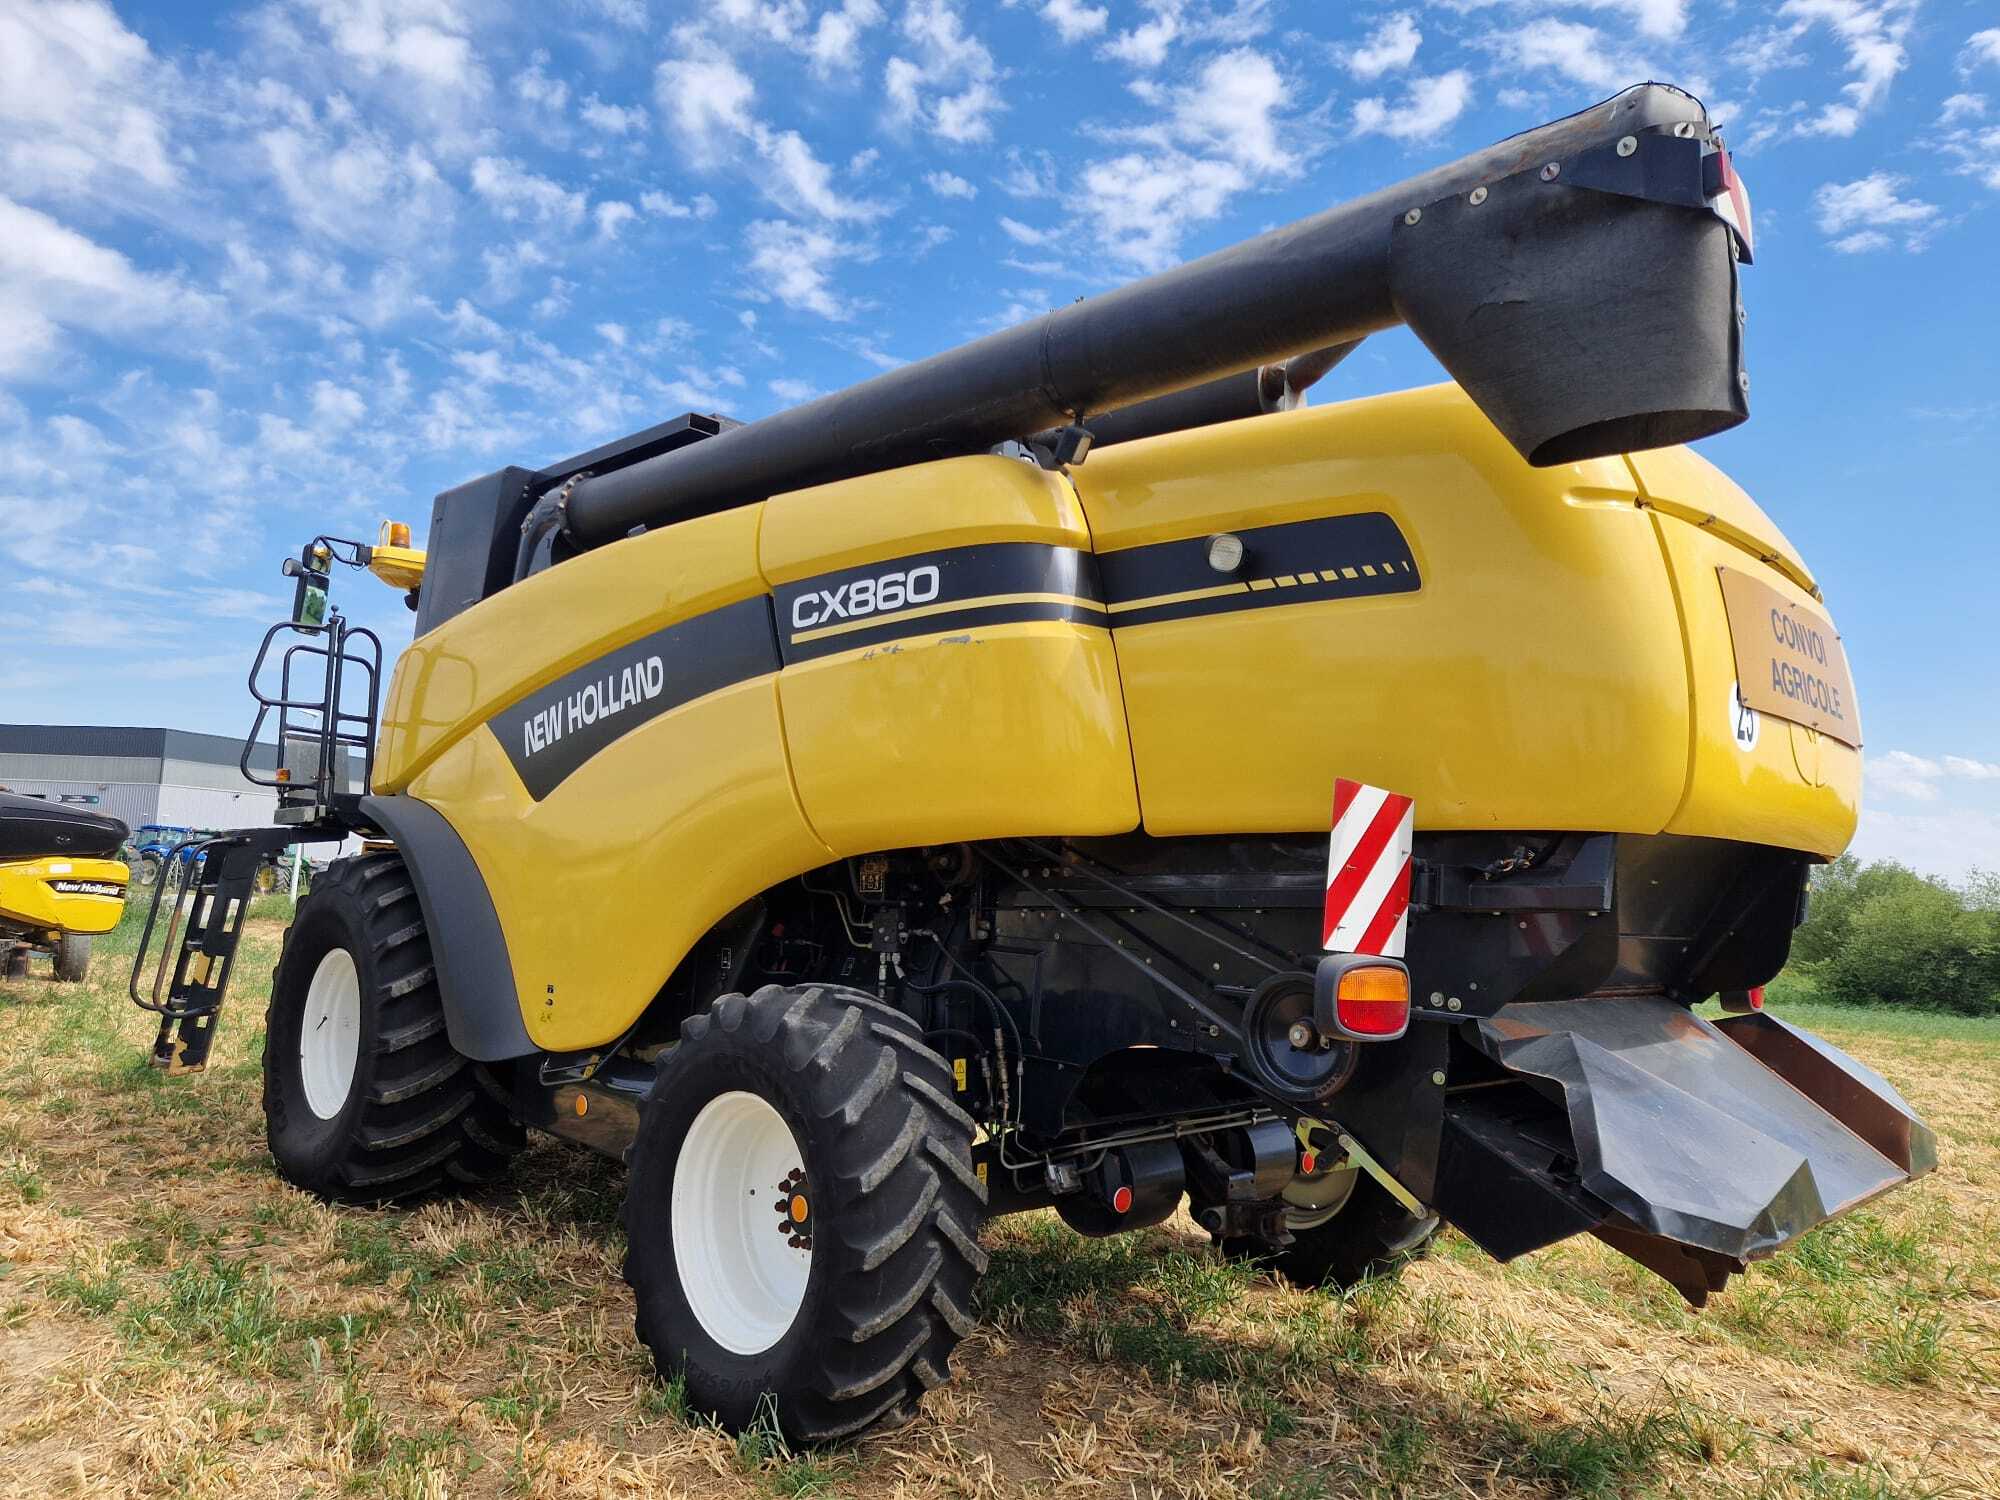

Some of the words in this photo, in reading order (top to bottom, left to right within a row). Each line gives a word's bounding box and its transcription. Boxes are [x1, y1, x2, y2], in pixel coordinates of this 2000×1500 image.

[792, 565, 940, 628] CX860
[1770, 608, 1828, 667] CONVOI
[524, 701, 563, 758] NEW
[567, 655, 664, 734] HOLLAND
[1771, 657, 1844, 721] AGRICOLE
[56, 882, 80, 892] New
[81, 883, 120, 896] Holland
